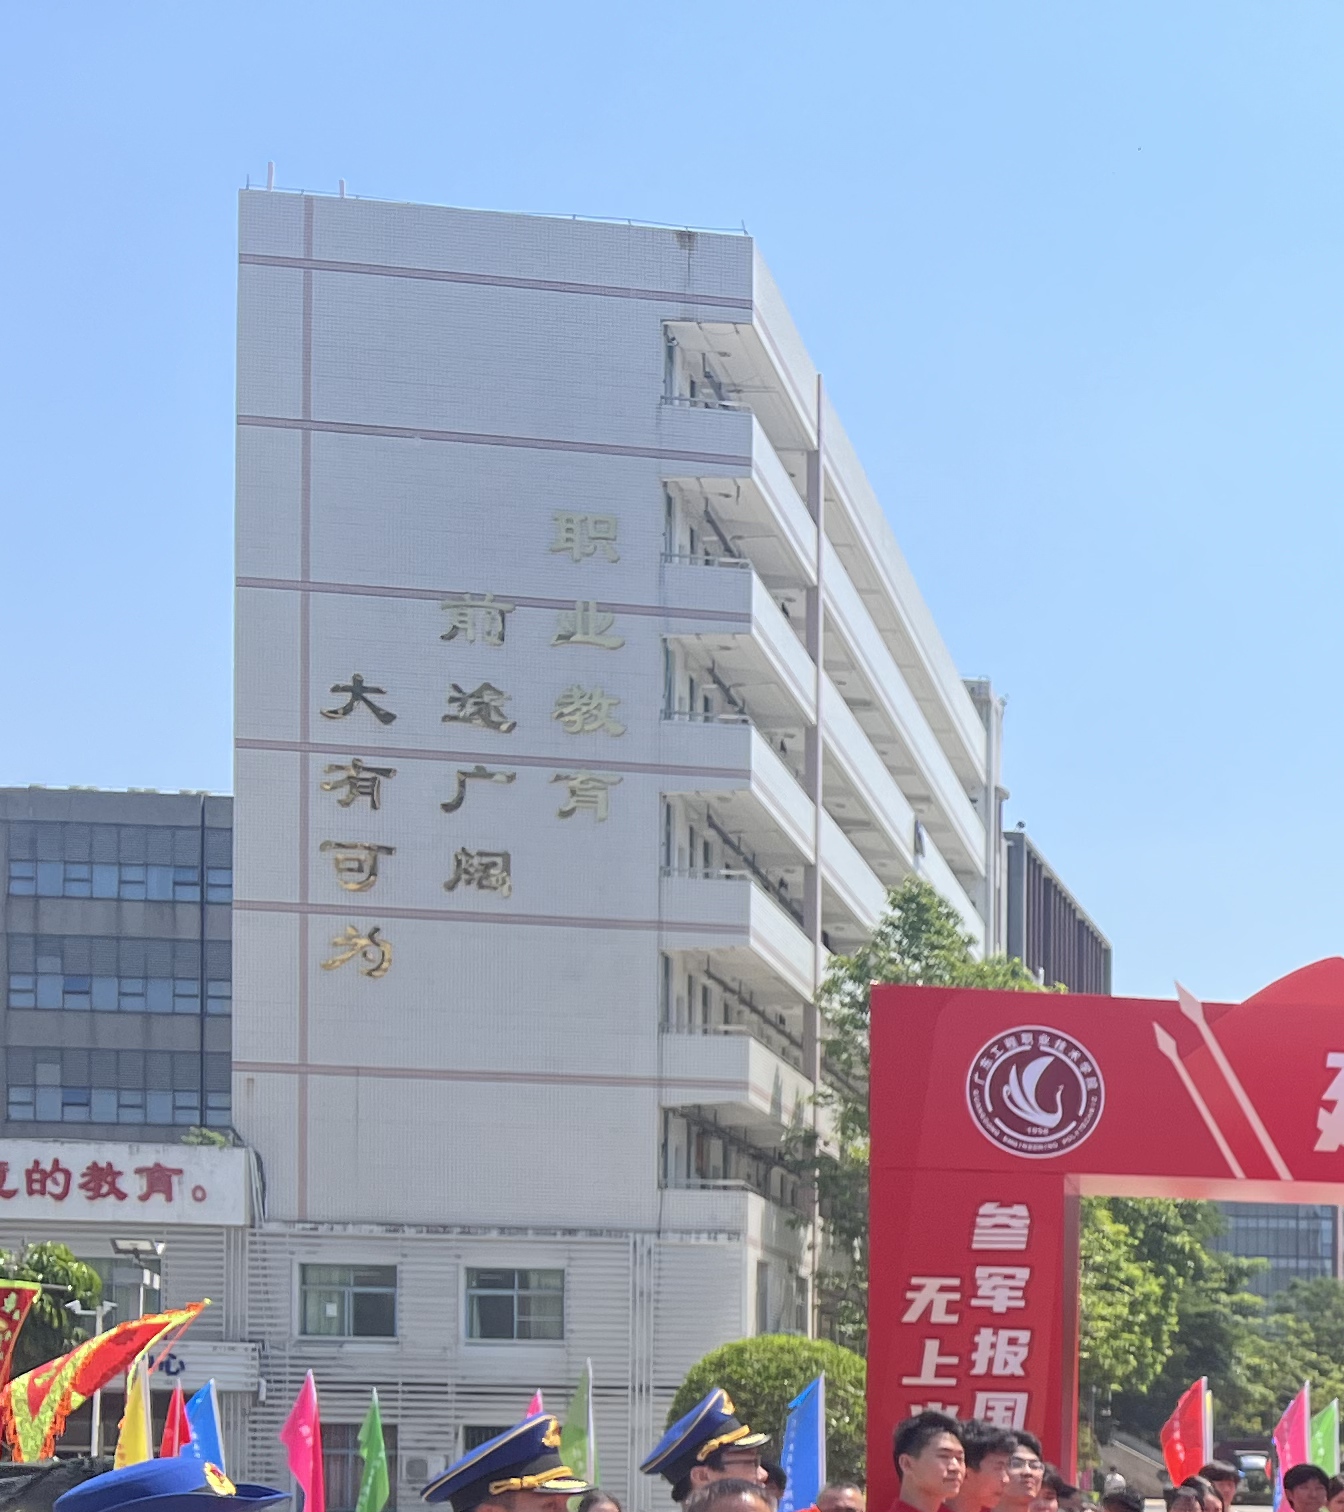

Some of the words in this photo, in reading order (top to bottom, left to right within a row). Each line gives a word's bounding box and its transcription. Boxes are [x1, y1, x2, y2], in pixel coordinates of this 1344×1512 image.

[440, 592, 518, 898] 前途广阔
[548, 510, 627, 823] 职业教育
[319, 672, 397, 979] 大有可为
[901, 1275, 962, 1418] 无上
